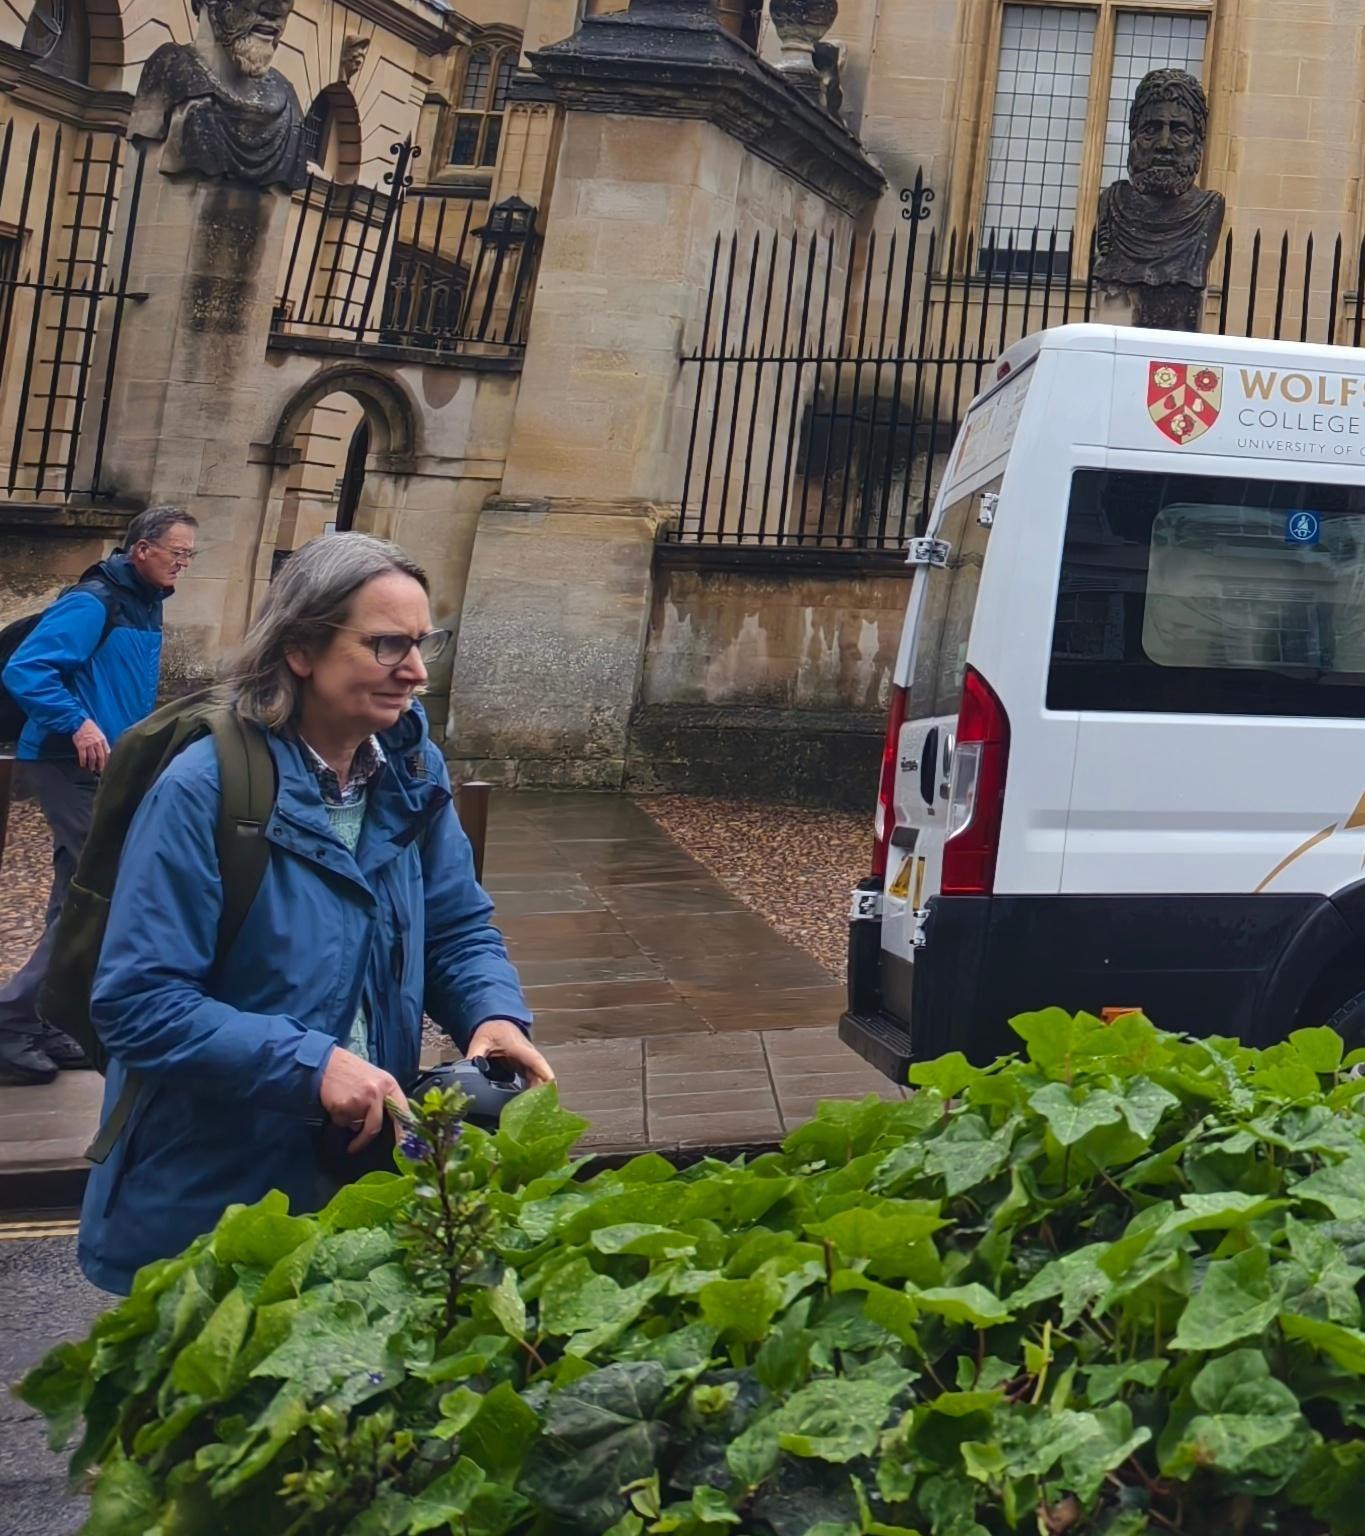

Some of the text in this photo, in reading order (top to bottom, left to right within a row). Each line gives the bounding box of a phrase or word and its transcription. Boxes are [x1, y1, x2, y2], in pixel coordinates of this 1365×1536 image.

[1238, 408, 1360, 435] COLLEGE
[1237, 437, 1327, 455] UNIVERSITY
[1334, 444, 1353, 456] OF
